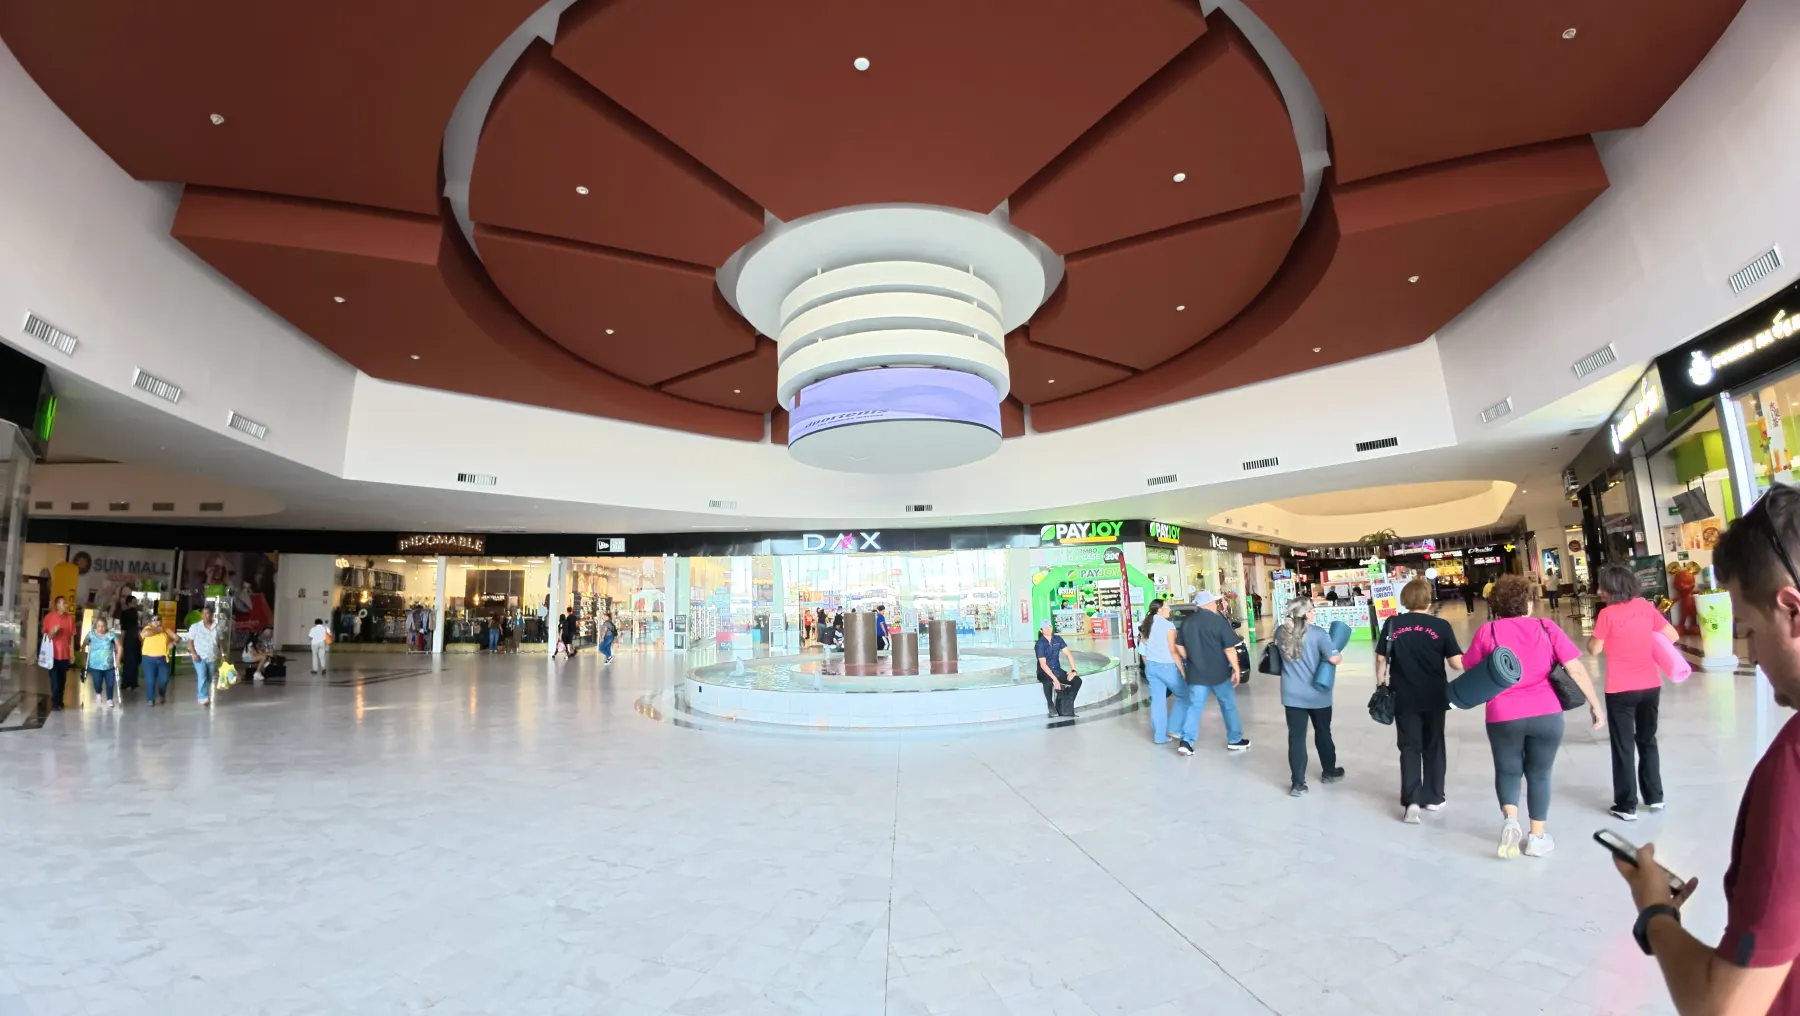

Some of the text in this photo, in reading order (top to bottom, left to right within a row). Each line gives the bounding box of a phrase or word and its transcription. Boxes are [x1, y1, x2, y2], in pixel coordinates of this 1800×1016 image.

[1055, 521, 1124, 539] PAYJOY
[1155, 522, 1180, 540] PAYJOY
[400, 534, 483, 552] INDOMABLE
[802, 531, 882, 551] DAX
[92, 558, 171, 575] SUN MALL
[1080, 568, 1120, 578] PAYJOY
